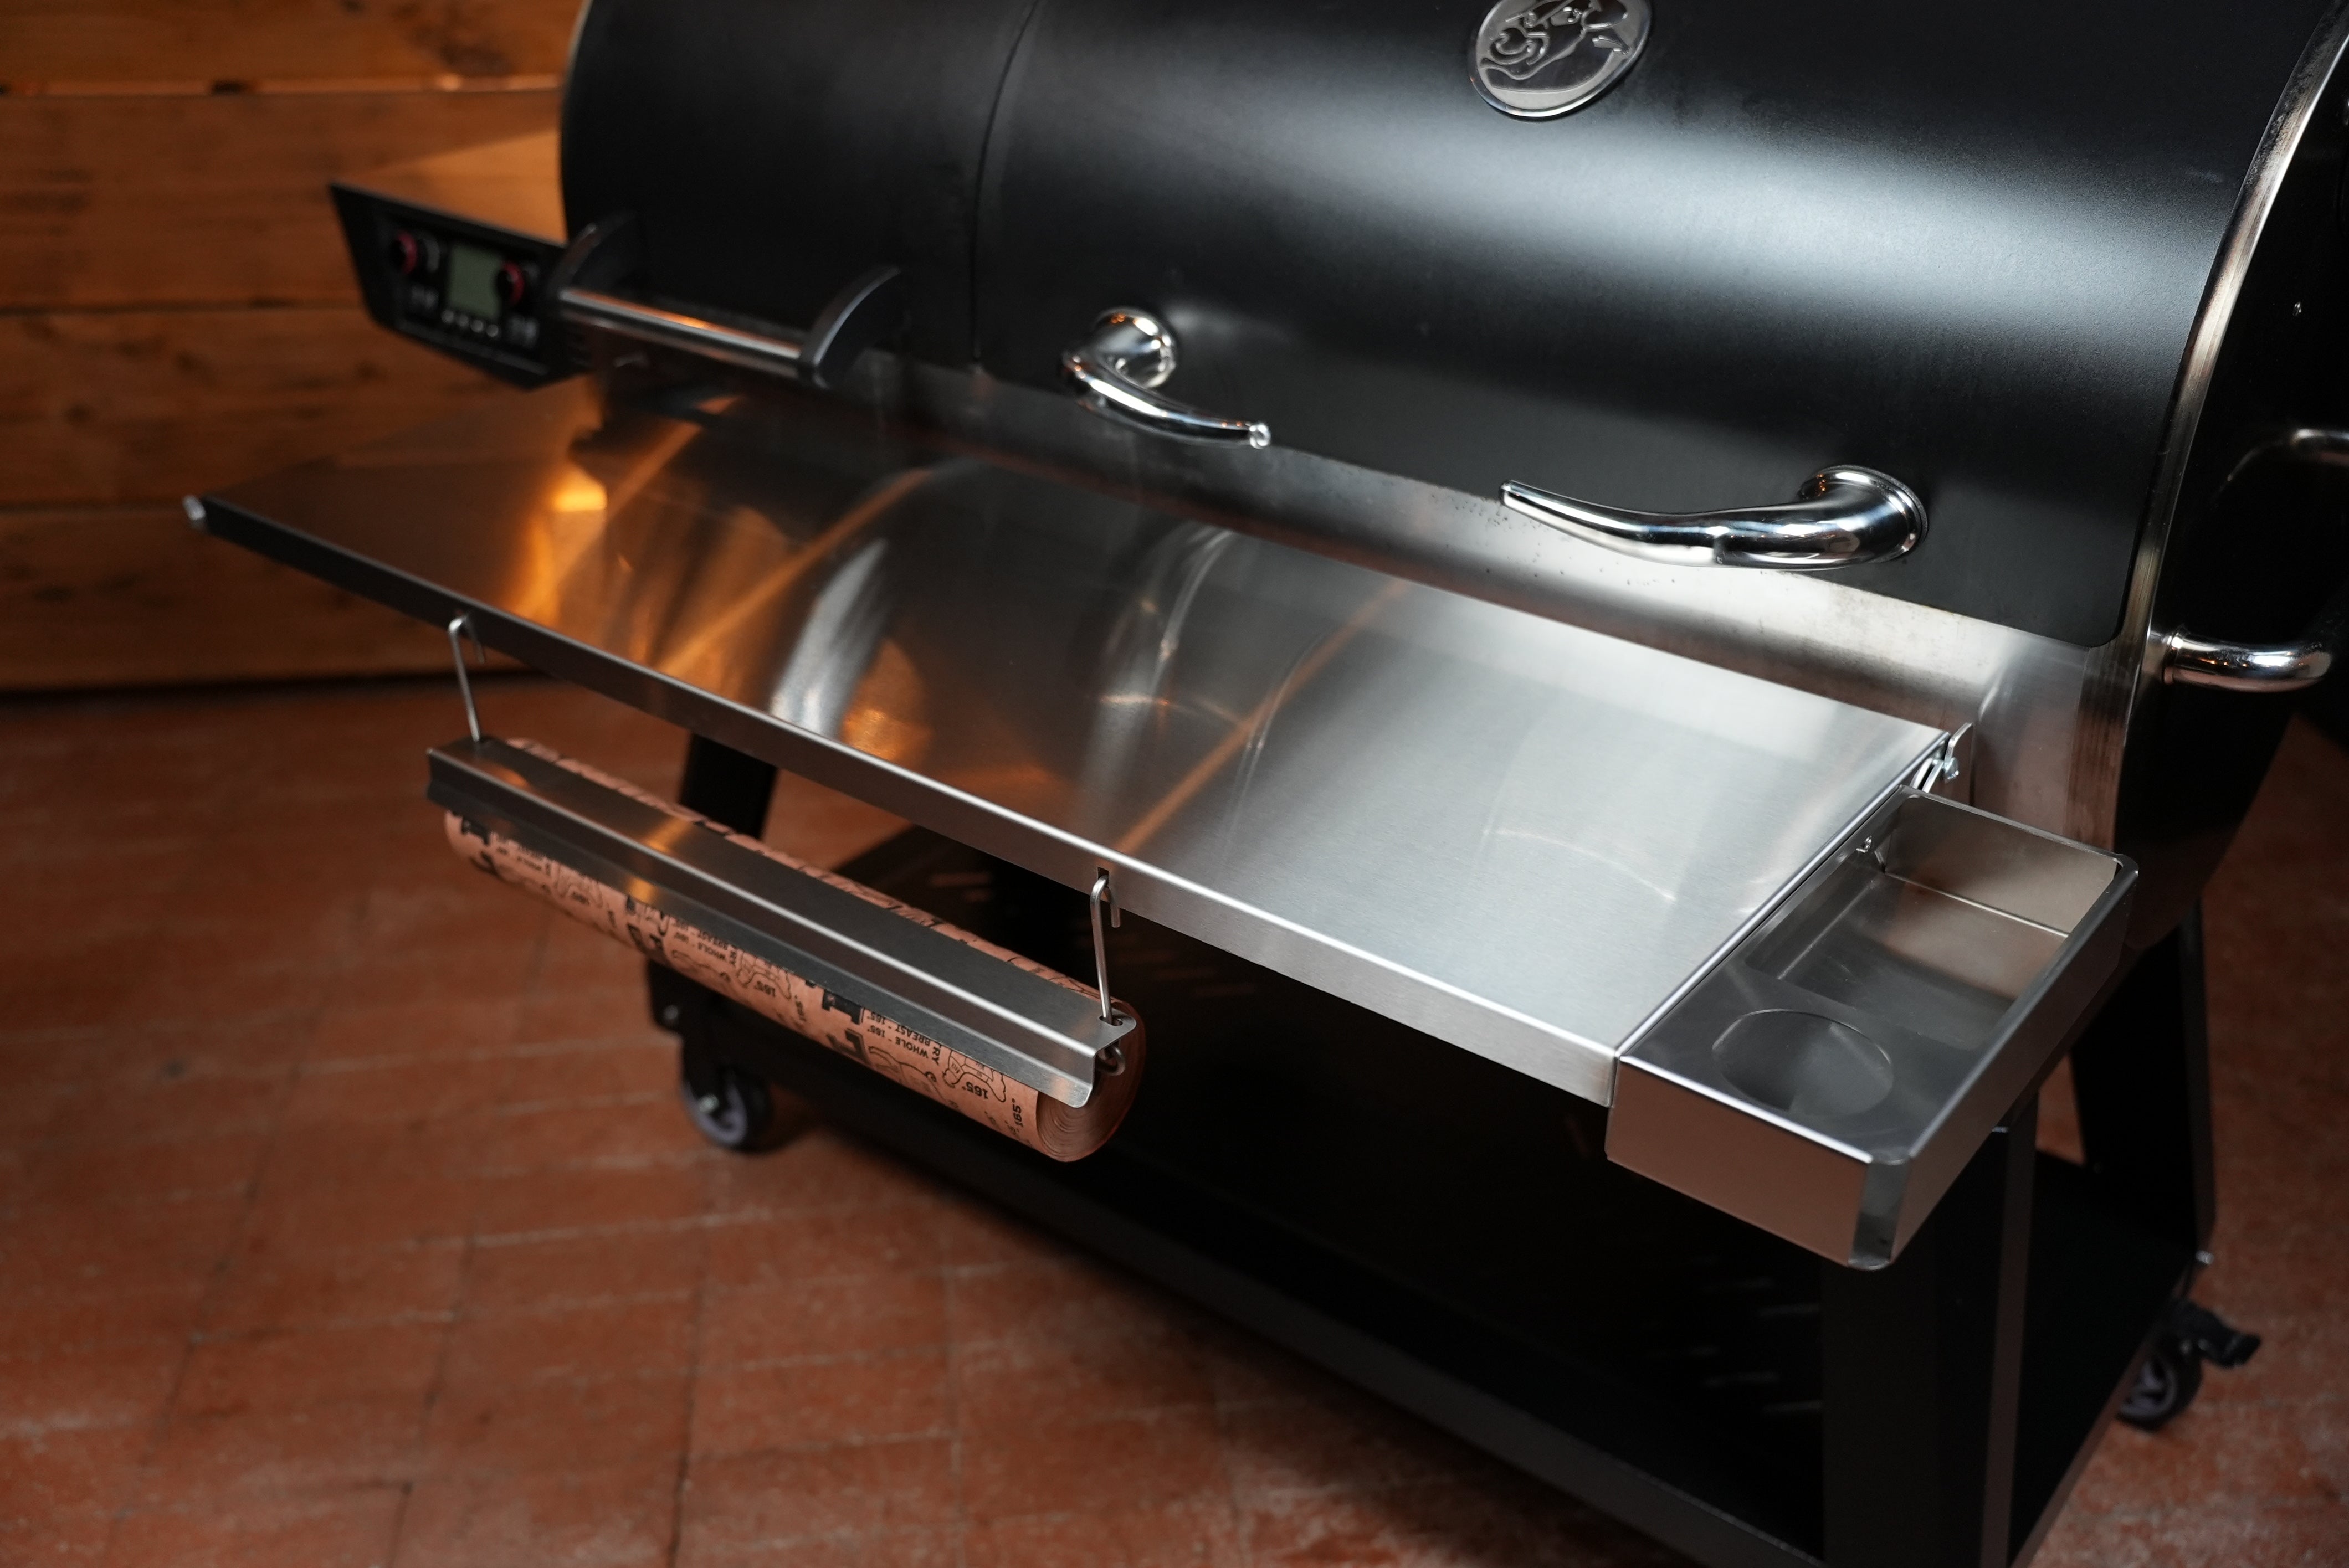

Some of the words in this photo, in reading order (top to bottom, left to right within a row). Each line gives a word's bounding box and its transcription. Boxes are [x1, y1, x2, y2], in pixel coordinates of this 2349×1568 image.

[895, 1024, 931, 1046] BREAST
[895, 1036, 929, 1058] WHOLE
[962, 1081, 988, 1099] 165°
[1012, 1098, 1024, 1128] 165°
